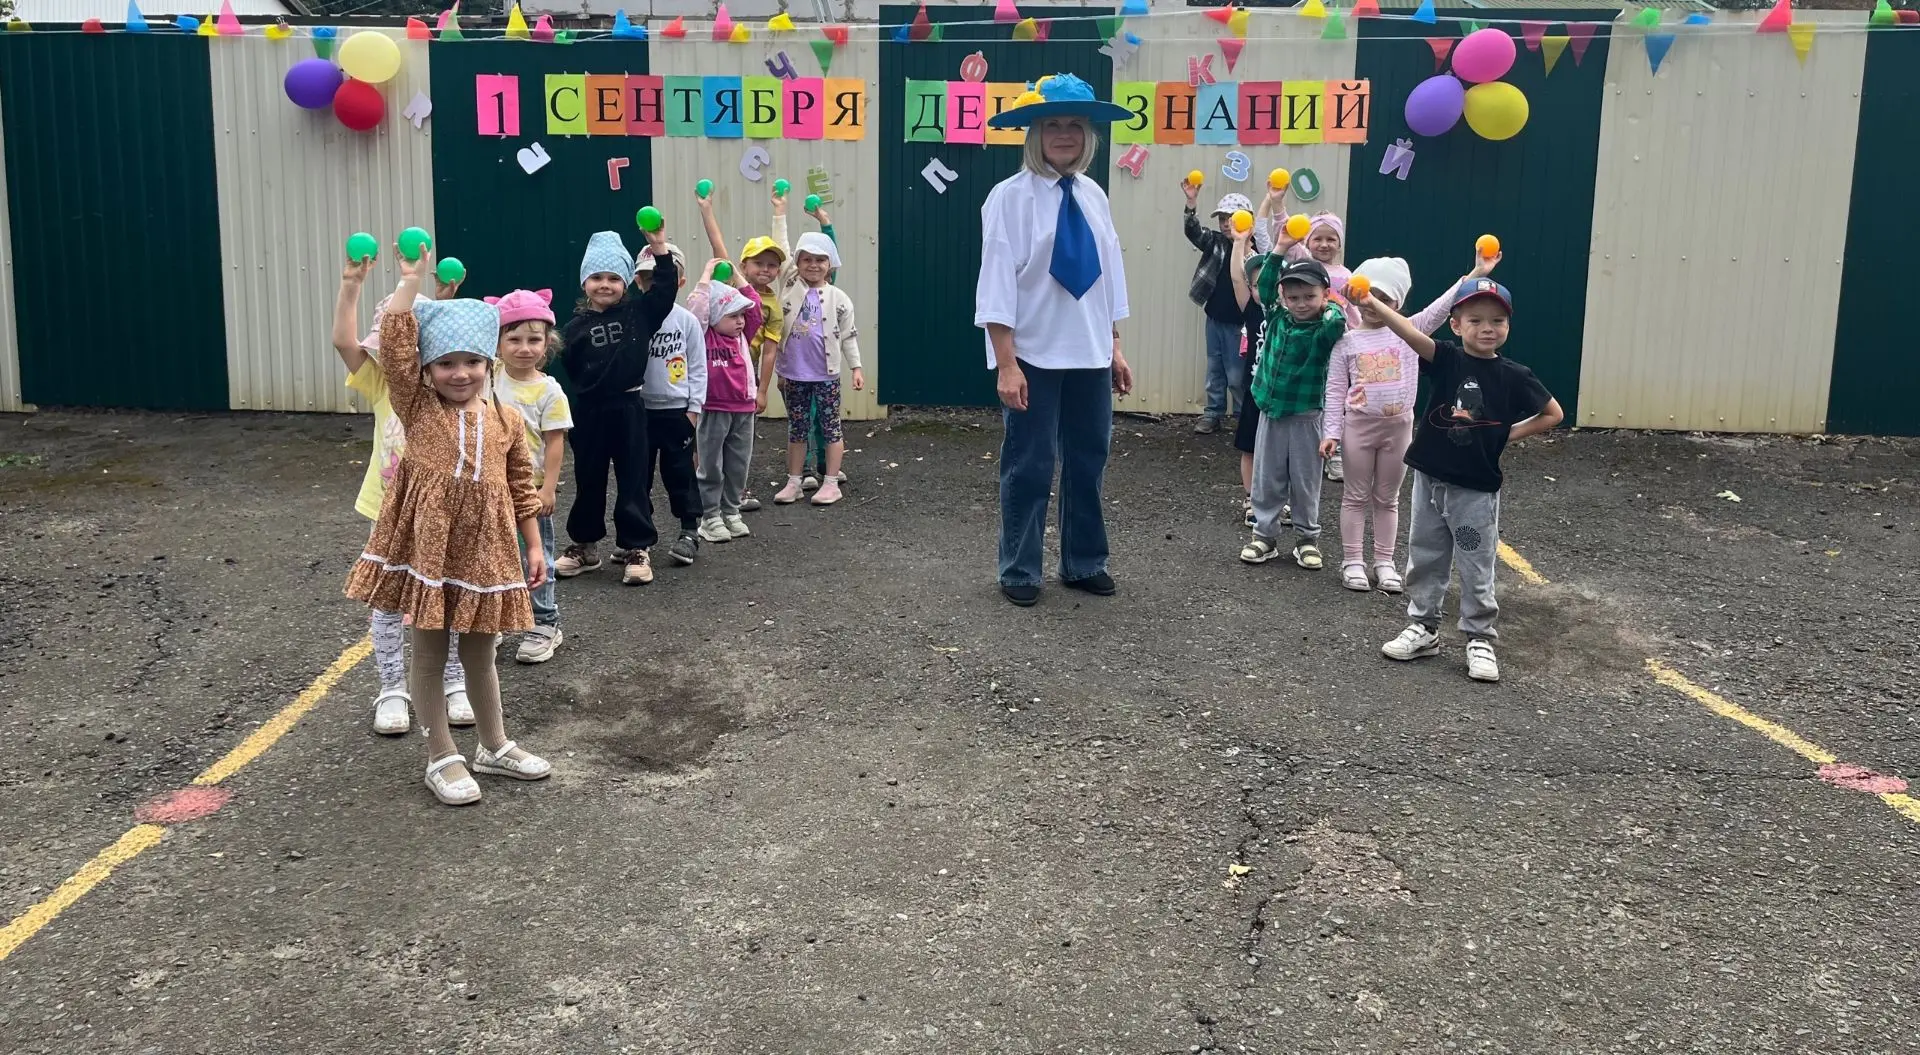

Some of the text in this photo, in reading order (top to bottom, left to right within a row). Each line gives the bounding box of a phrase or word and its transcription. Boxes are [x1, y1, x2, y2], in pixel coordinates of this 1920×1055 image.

[764, 50, 799, 80] Ч
[960, 50, 987, 82] Ф
[1187, 53, 1216, 87] К
[492, 82, 1368, 137] 1 СЕНТЯБРЯ ДЕ ЗНАНИЙ
[607, 157, 630, 190] Г
[1116, 143, 1150, 177] Д
[1379, 137, 1416, 180] Й
[650, 329, 682, 347] УТОЙ
